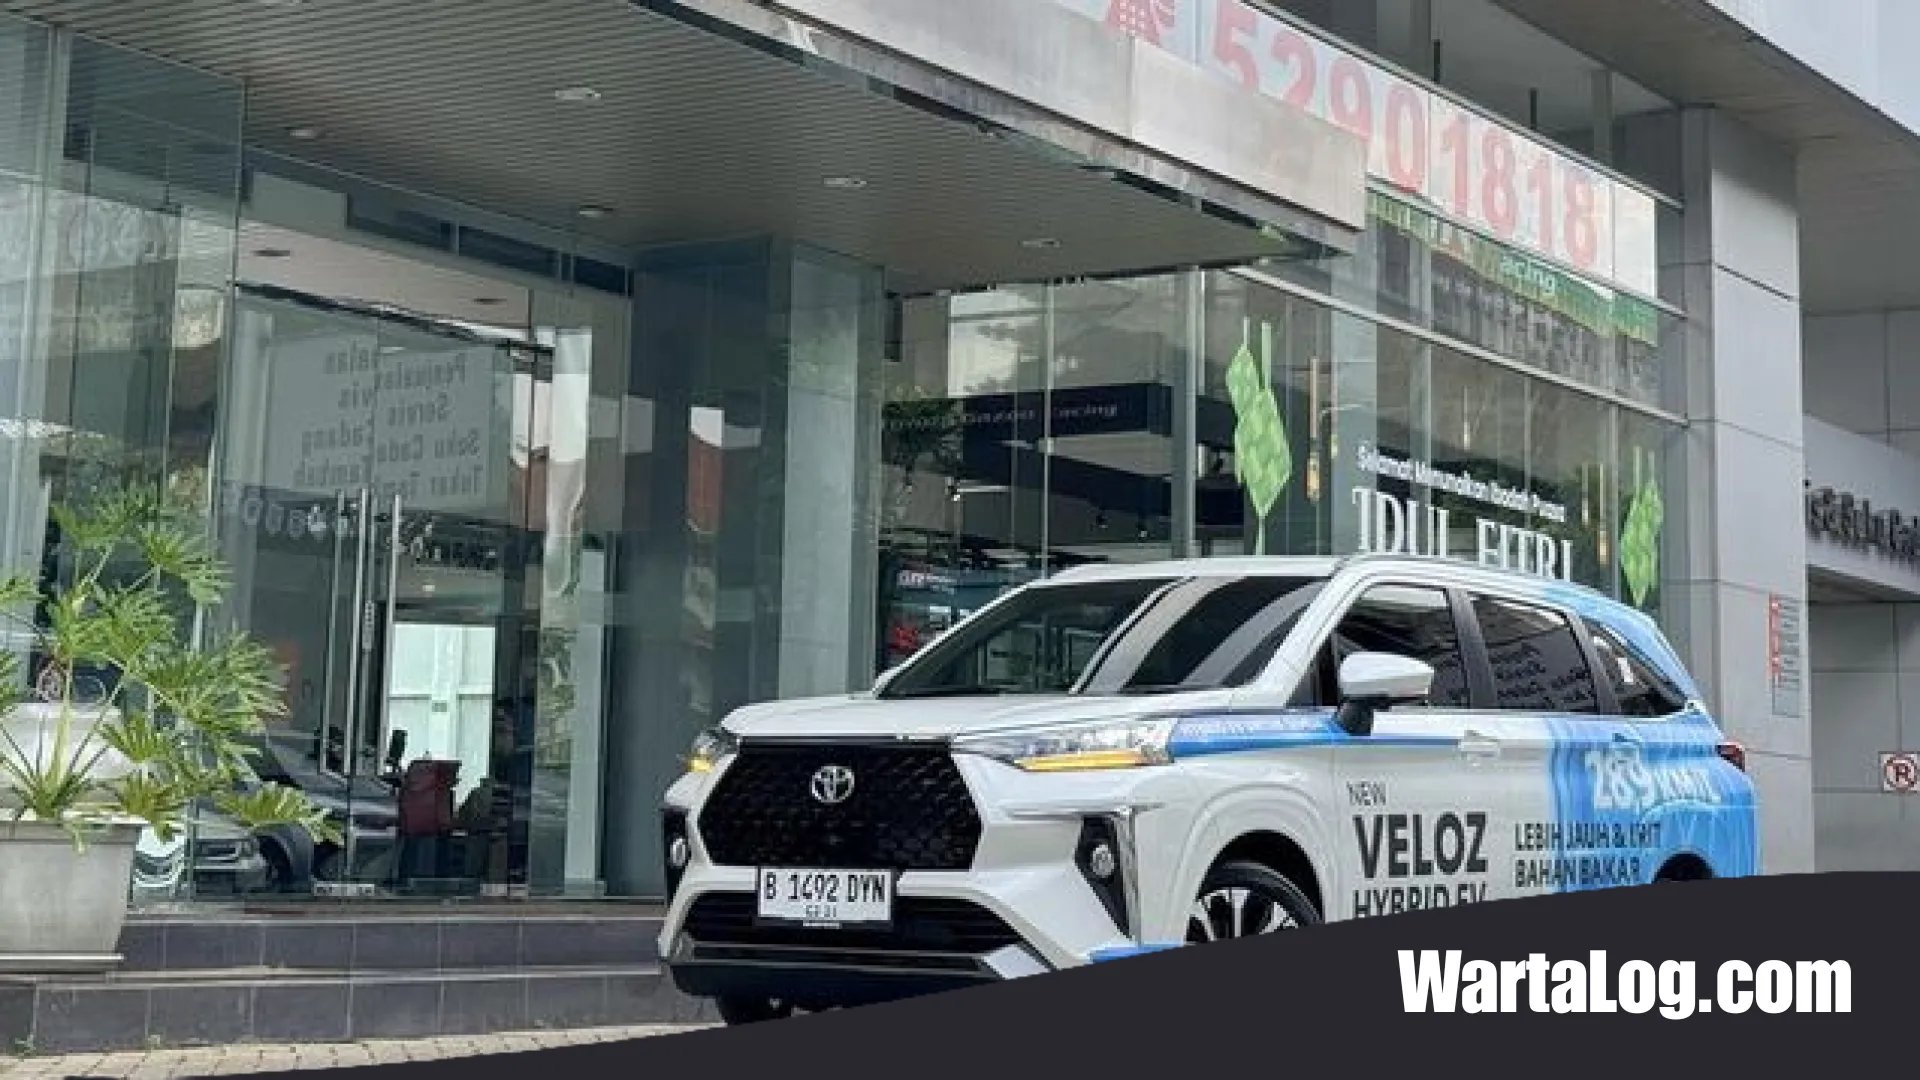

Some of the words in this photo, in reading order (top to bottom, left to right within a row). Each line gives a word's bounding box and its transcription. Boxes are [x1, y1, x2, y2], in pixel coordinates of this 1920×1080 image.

[1476, 517, 1573, 583] FITRI
[1347, 781, 1387, 806] NEW
[1353, 812, 1488, 879] VELOZ
[1515, 822, 1562, 851] LEBIH
[1566, 822, 1611, 850] JAUH
[1612, 822, 1626, 849] &
[766, 871, 777, 900] B
[847, 874, 886, 903] DYN
[1514, 859, 1577, 888] BAHAN
[1579, 856, 1641, 884] BAKAR
